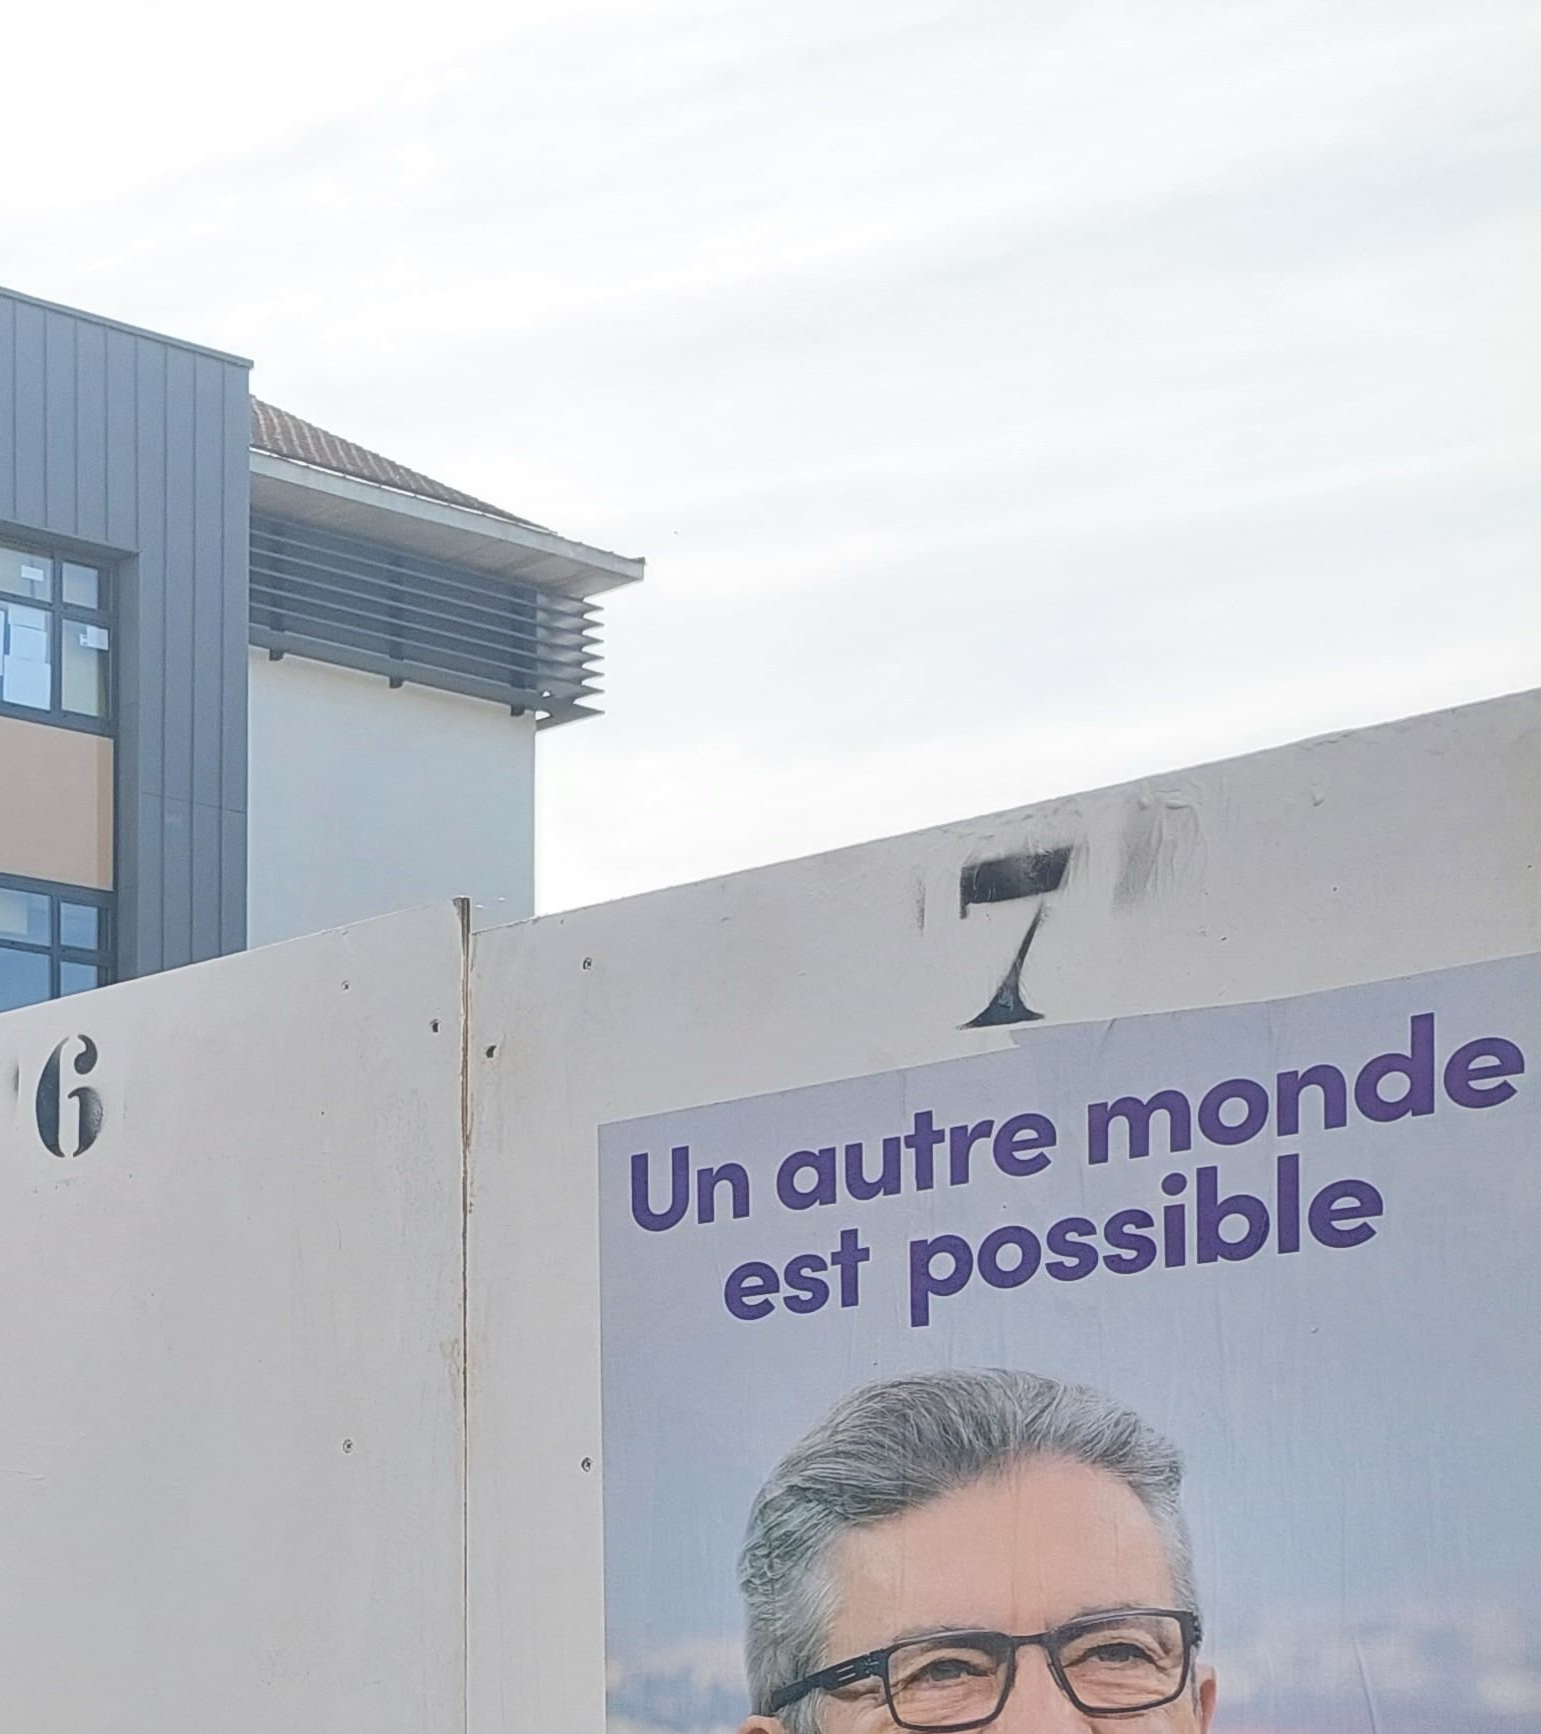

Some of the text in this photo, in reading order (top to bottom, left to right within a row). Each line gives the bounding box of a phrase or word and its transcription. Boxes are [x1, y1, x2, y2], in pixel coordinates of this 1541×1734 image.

[958, 846, 1074, 1029] 7
[35, 1033, 104, 1159] 6
[629, 1011, 1526, 1233] Un autre monde
[723, 1153, 1385, 1328] est possible
